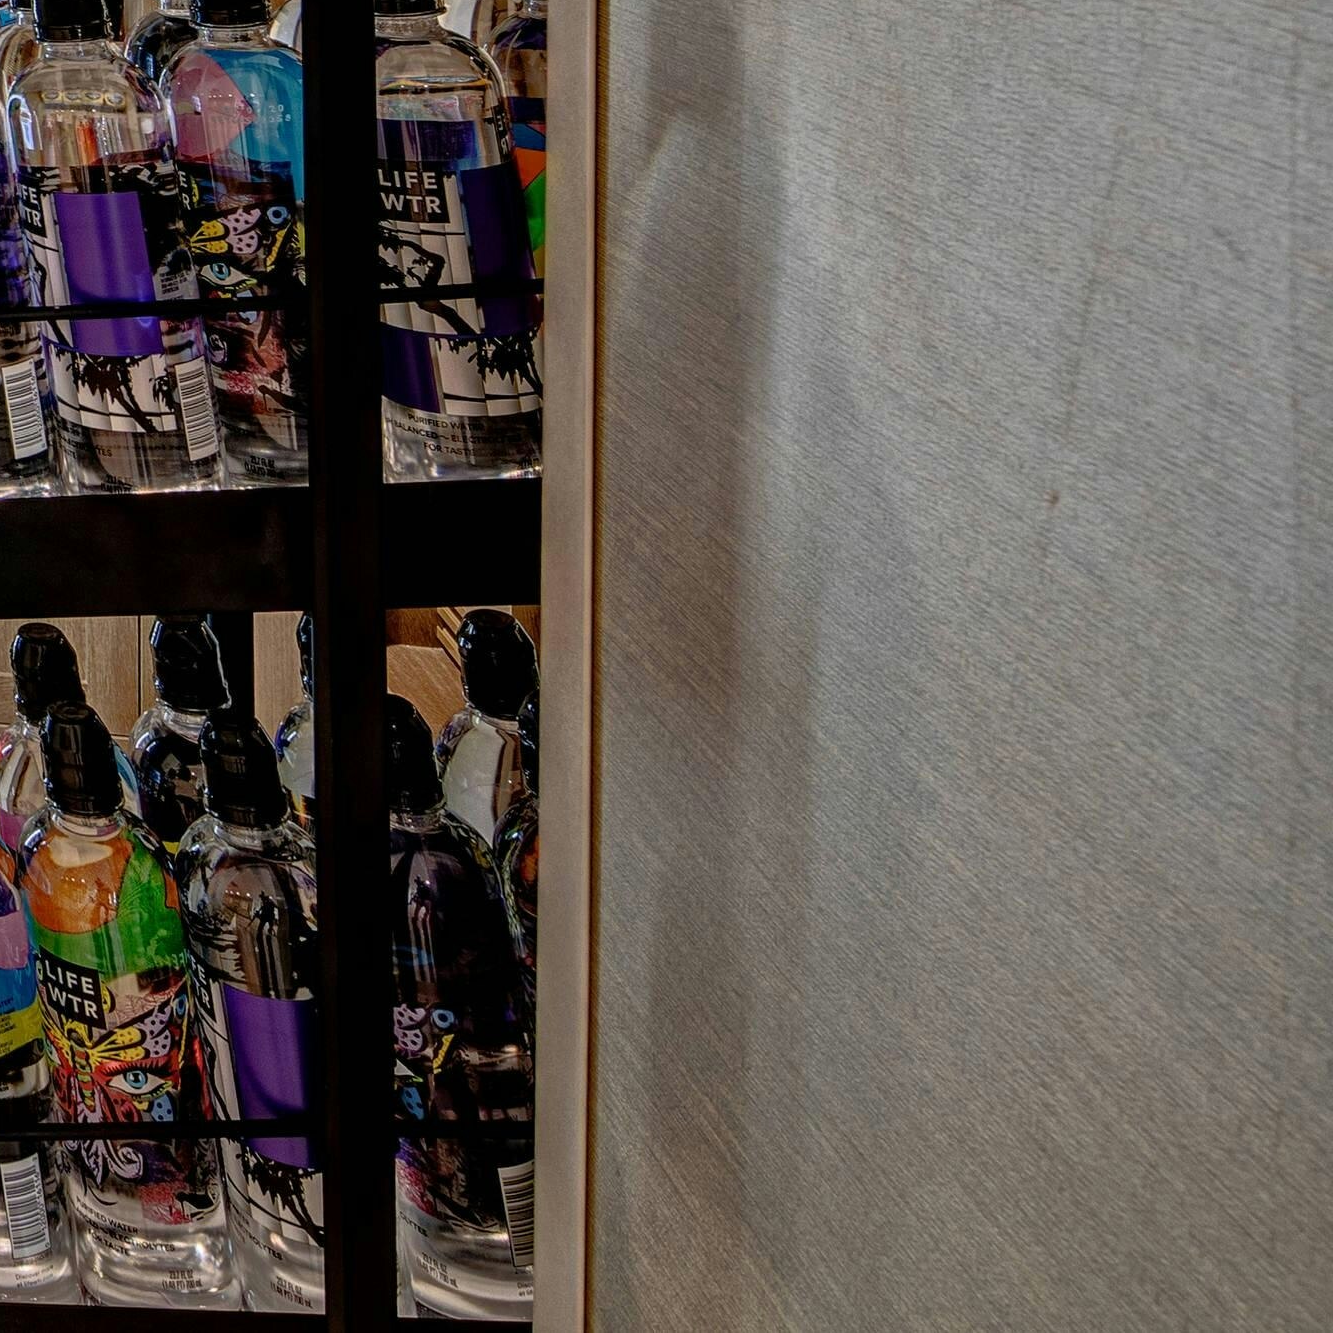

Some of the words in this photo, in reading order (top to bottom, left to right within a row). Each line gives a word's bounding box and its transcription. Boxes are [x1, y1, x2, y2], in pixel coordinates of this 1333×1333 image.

[378, 169, 438, 189] LIFE
[381, 192, 441, 214] WTR
[408, 413, 448, 428] PURIFIED
[424, 442, 442, 452] FOR
[45, 960, 94, 996] LIFE
[48, 982, 98, 1019] WTR
[109, 1220, 138, 1234] WATER
